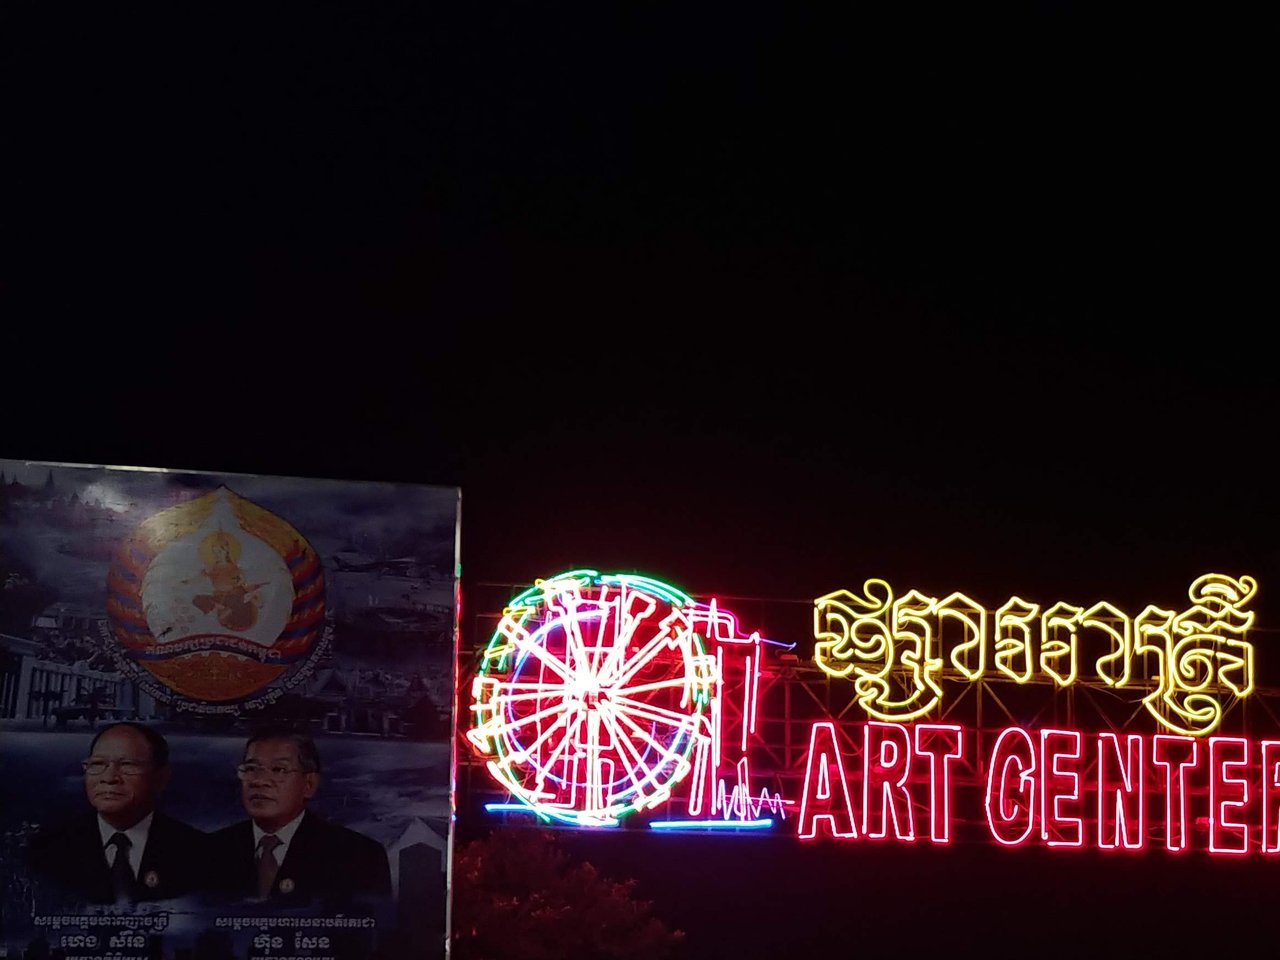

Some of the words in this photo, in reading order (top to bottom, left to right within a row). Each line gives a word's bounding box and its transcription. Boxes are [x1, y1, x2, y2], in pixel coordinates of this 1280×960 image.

[813, 573, 1258, 735] ផ្សាររាត្រី
[797, 720, 964, 844] ART
